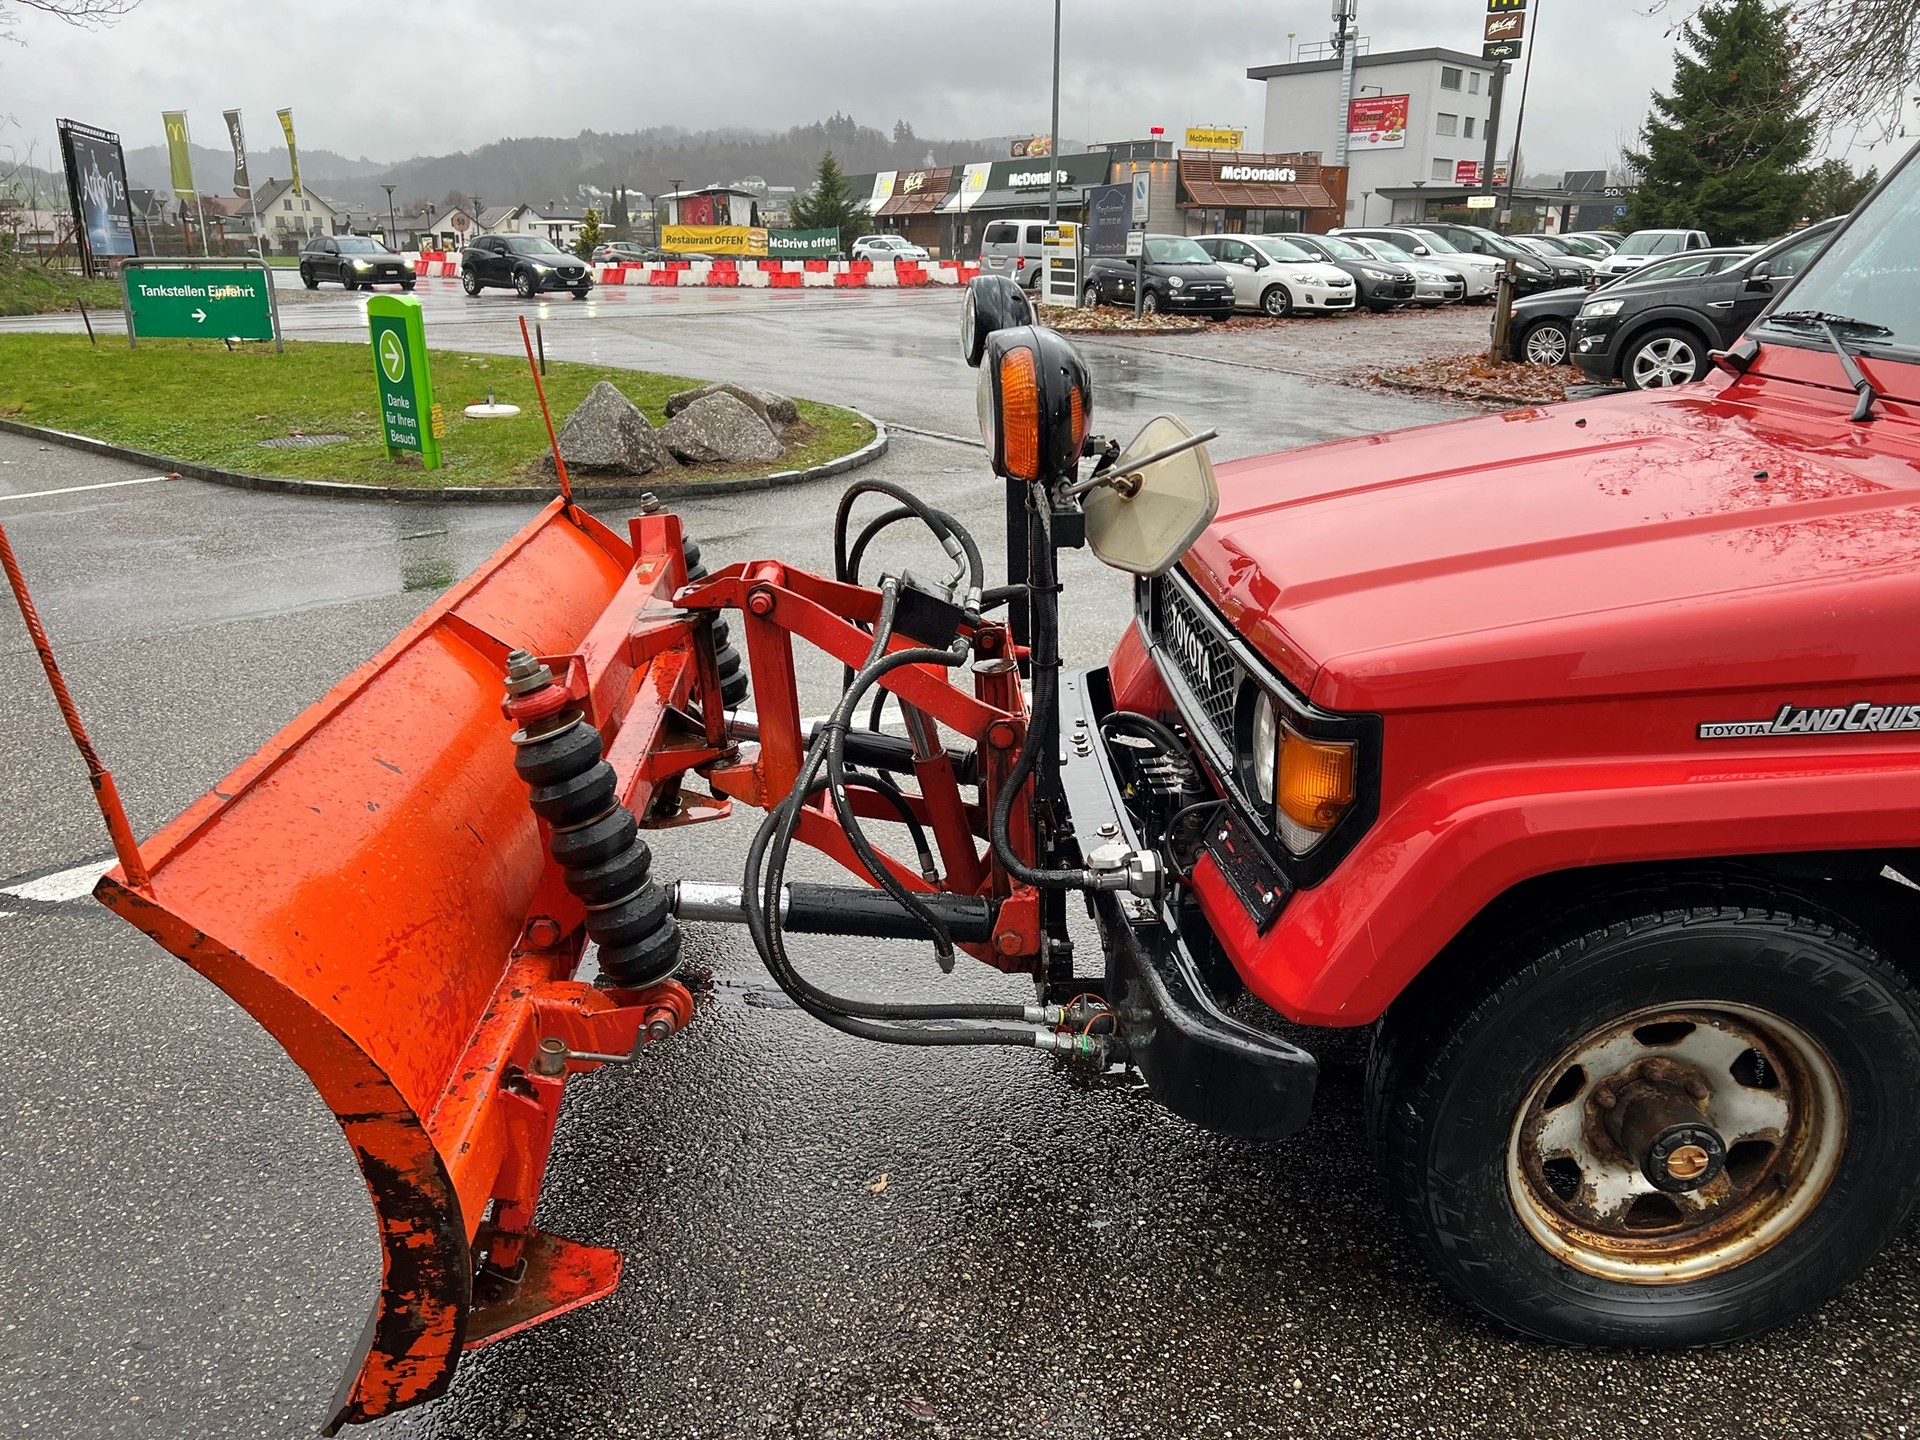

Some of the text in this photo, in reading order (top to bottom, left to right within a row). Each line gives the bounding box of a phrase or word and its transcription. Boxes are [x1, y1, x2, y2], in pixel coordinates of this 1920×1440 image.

[1189, 134, 1213, 143] McDrive
[1008, 169, 1068, 187] McDonal's
[1220, 165, 1297, 182] McDonald's
[666, 234, 744, 245] Restaurant OFFEN
[769, 236, 837, 249] McDrive offen
[138, 284, 256, 298] Tankstellen Einfahrt
[387, 393, 410, 409] Danke
[386, 410, 397, 424] für
[397, 412, 417, 428] Ihren
[390, 429, 417, 446] Besuch
[1171, 603, 1212, 691] TOYOTA
[1704, 724, 1766, 737] TOYOTA
